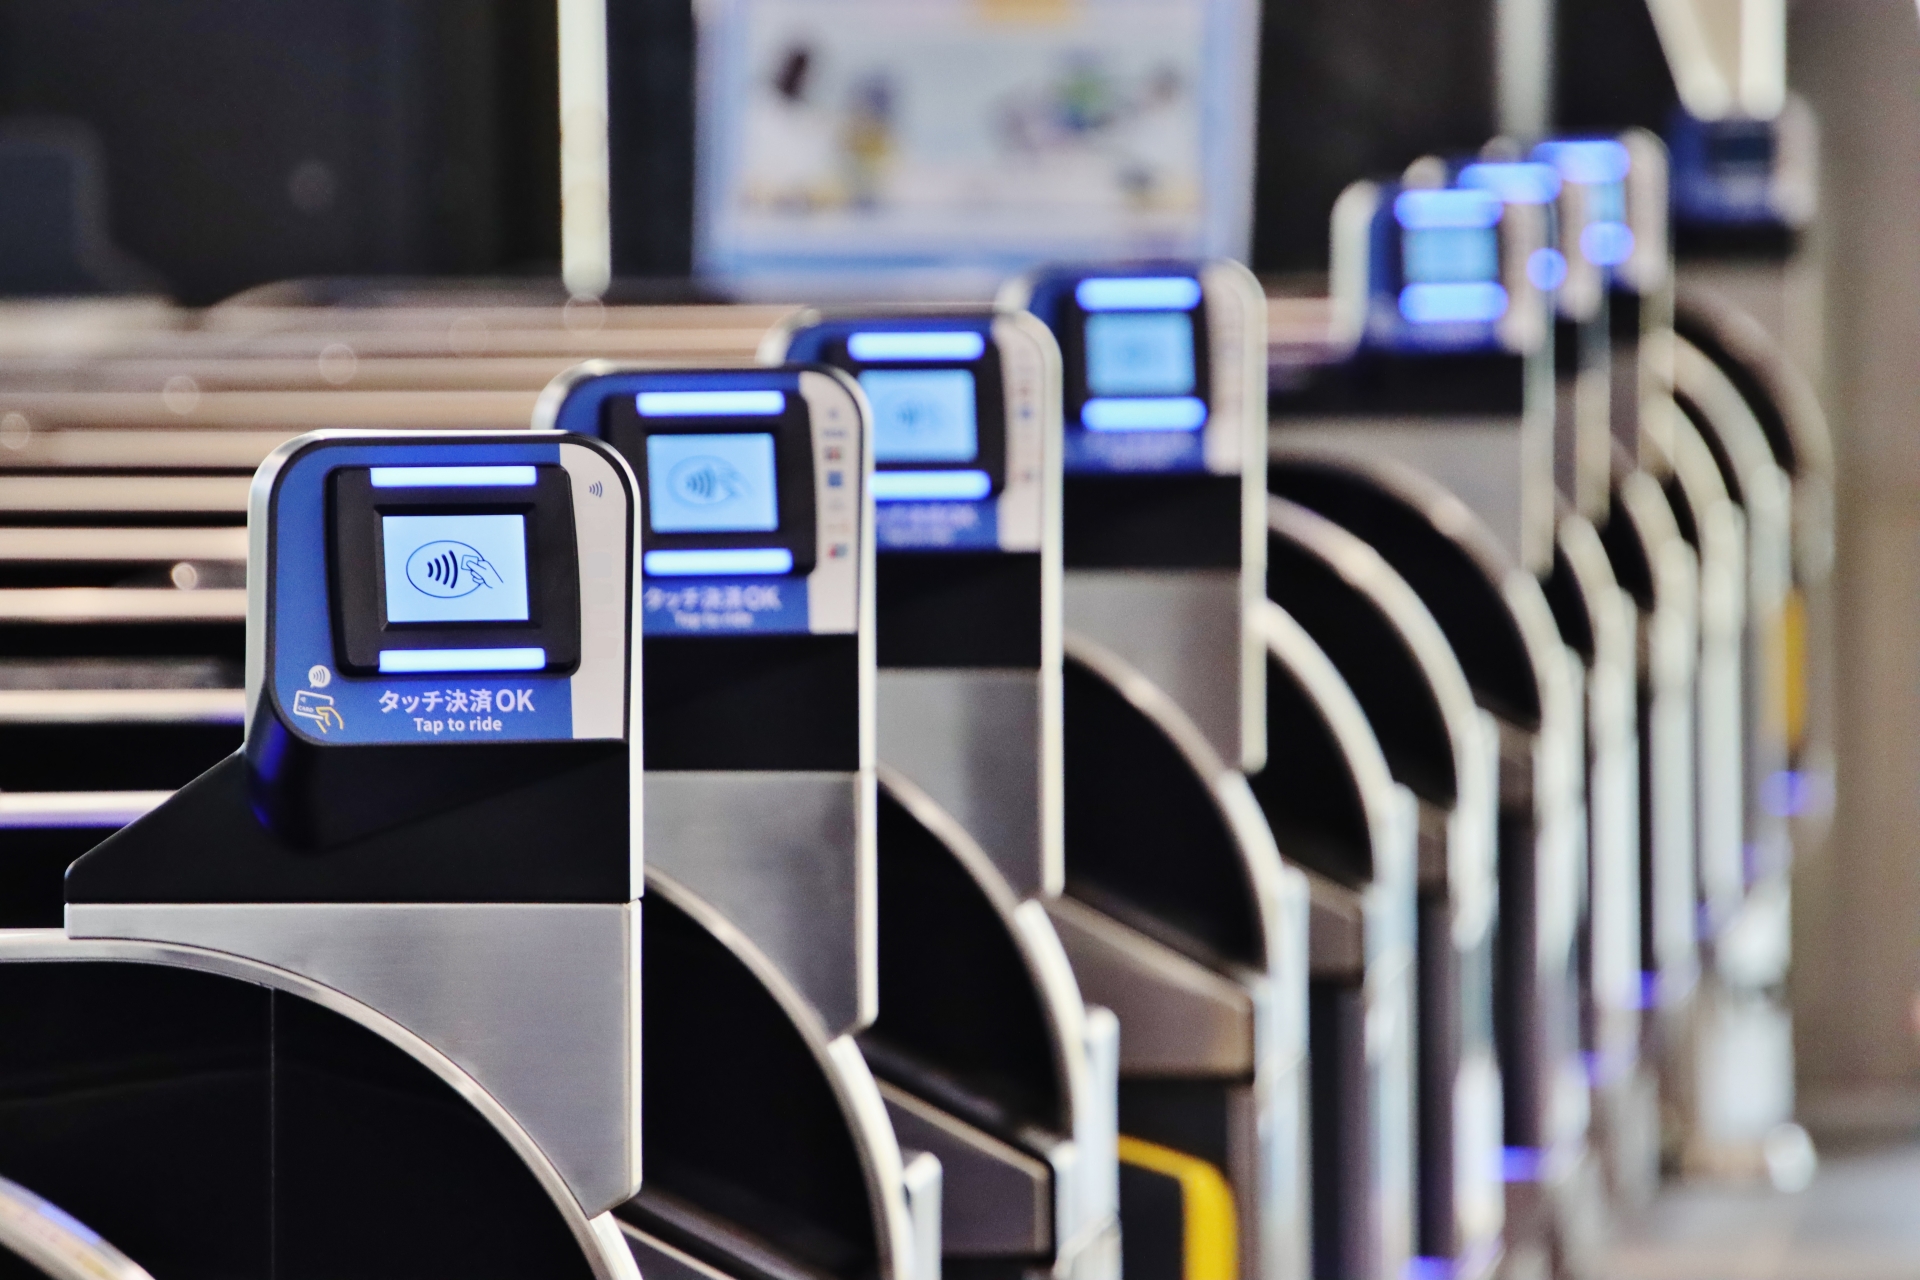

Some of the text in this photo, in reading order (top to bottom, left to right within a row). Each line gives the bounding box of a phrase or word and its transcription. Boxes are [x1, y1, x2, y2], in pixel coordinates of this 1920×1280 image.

[378, 688, 536, 713] タッチ決済OK
[413, 716, 503, 735] Tap to ride
